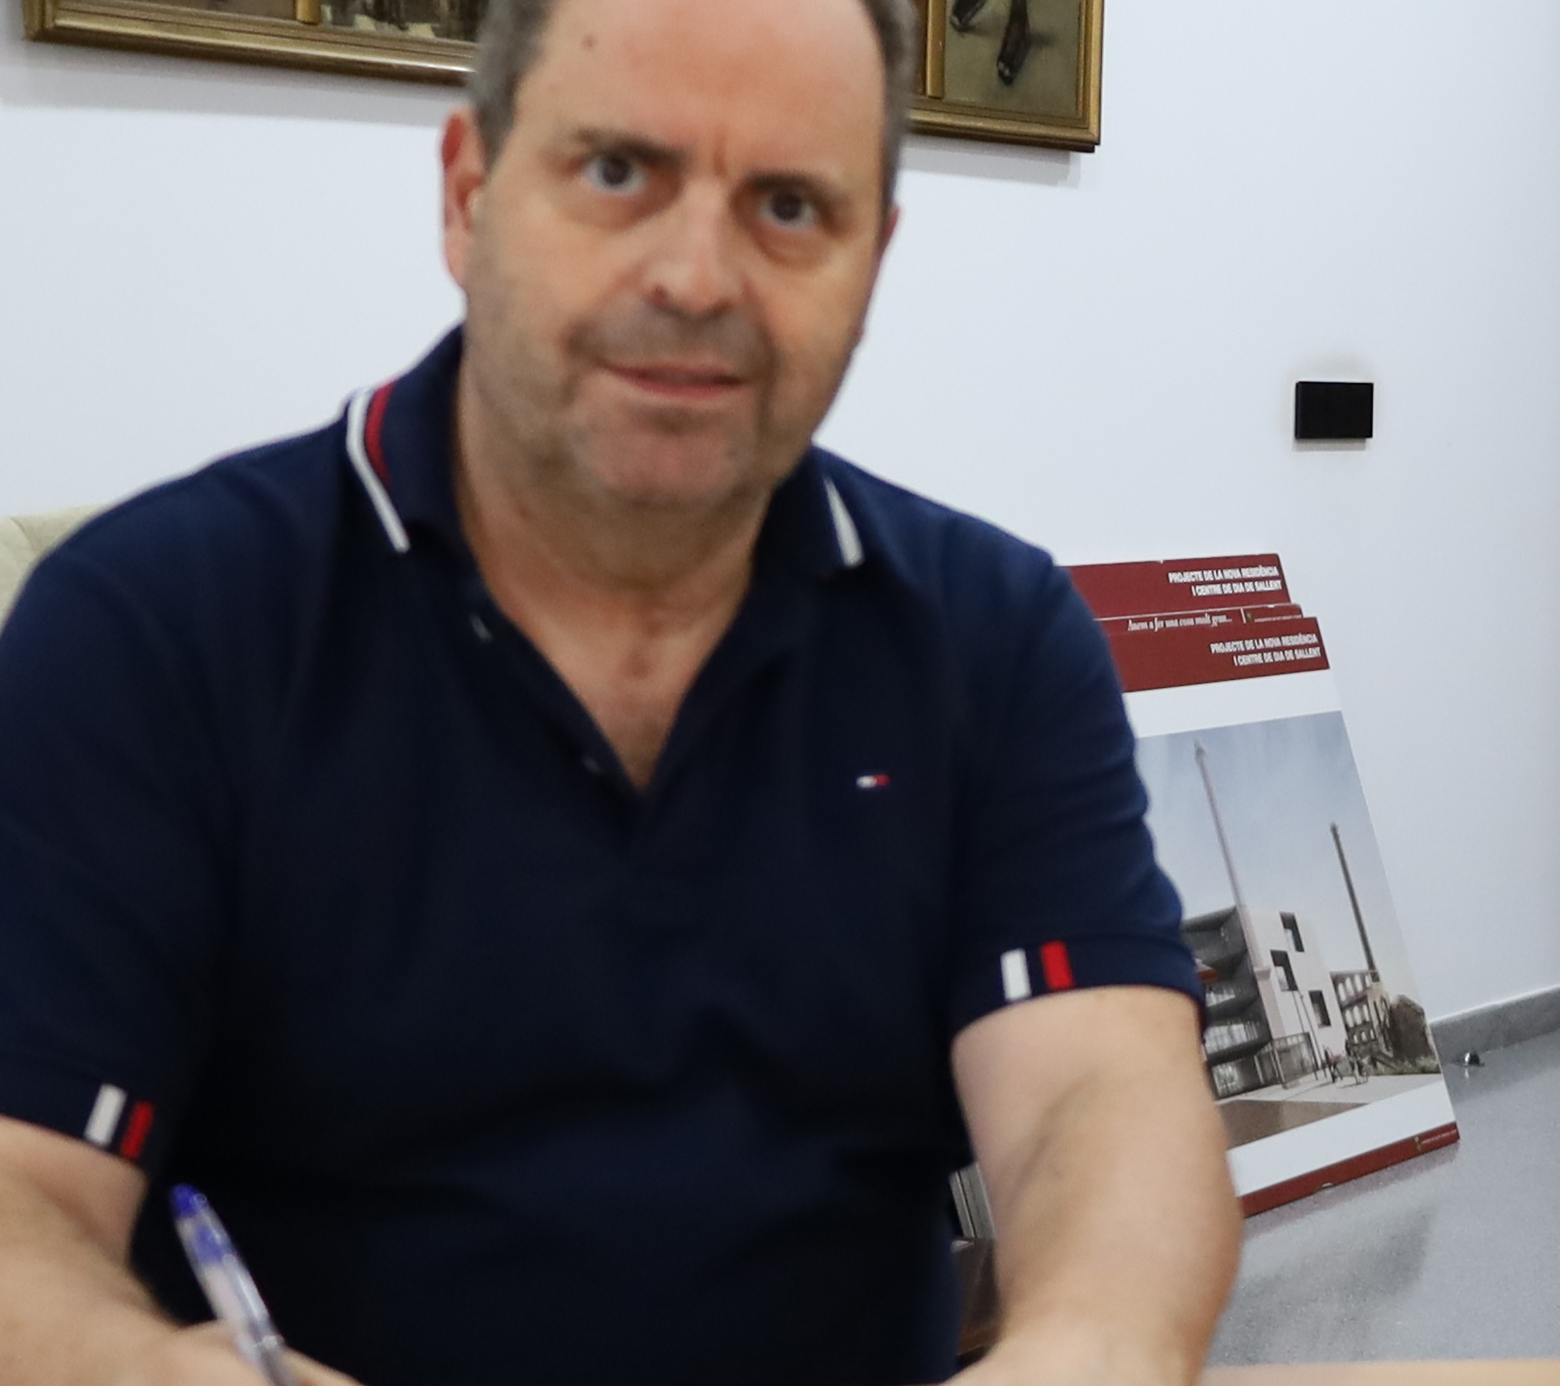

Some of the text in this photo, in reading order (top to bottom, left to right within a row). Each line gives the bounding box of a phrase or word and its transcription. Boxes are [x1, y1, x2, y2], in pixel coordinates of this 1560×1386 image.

[1167, 564, 1280, 584] PROJECTE DE LA NOVA RESIDÈNCIA
[1196, 583, 1223, 596] CENTRE
[1221, 582, 1233, 594] DE
[1231, 582, 1244, 594] DIA
[1243, 580, 1255, 593] DE
[1253, 579, 1283, 592] SALLENT
[1127, 619, 1149, 631] Anem
[1153, 616, 1165, 632] fer
[1164, 618, 1179, 628] una
[1178, 617, 1195, 627] cosa
[1194, 612, 1212, 625] molt
[1209, 632, 1319, 654] PROJECTE DE LA NOVA RESIDÈNCIA
[1237, 652, 1264, 666] CENTRE
[1262, 651, 1274, 664] DE
[1272, 650, 1285, 662] DIA
[1283, 649, 1295, 661] DE
[1293, 646, 1322, 660] SALLENT
